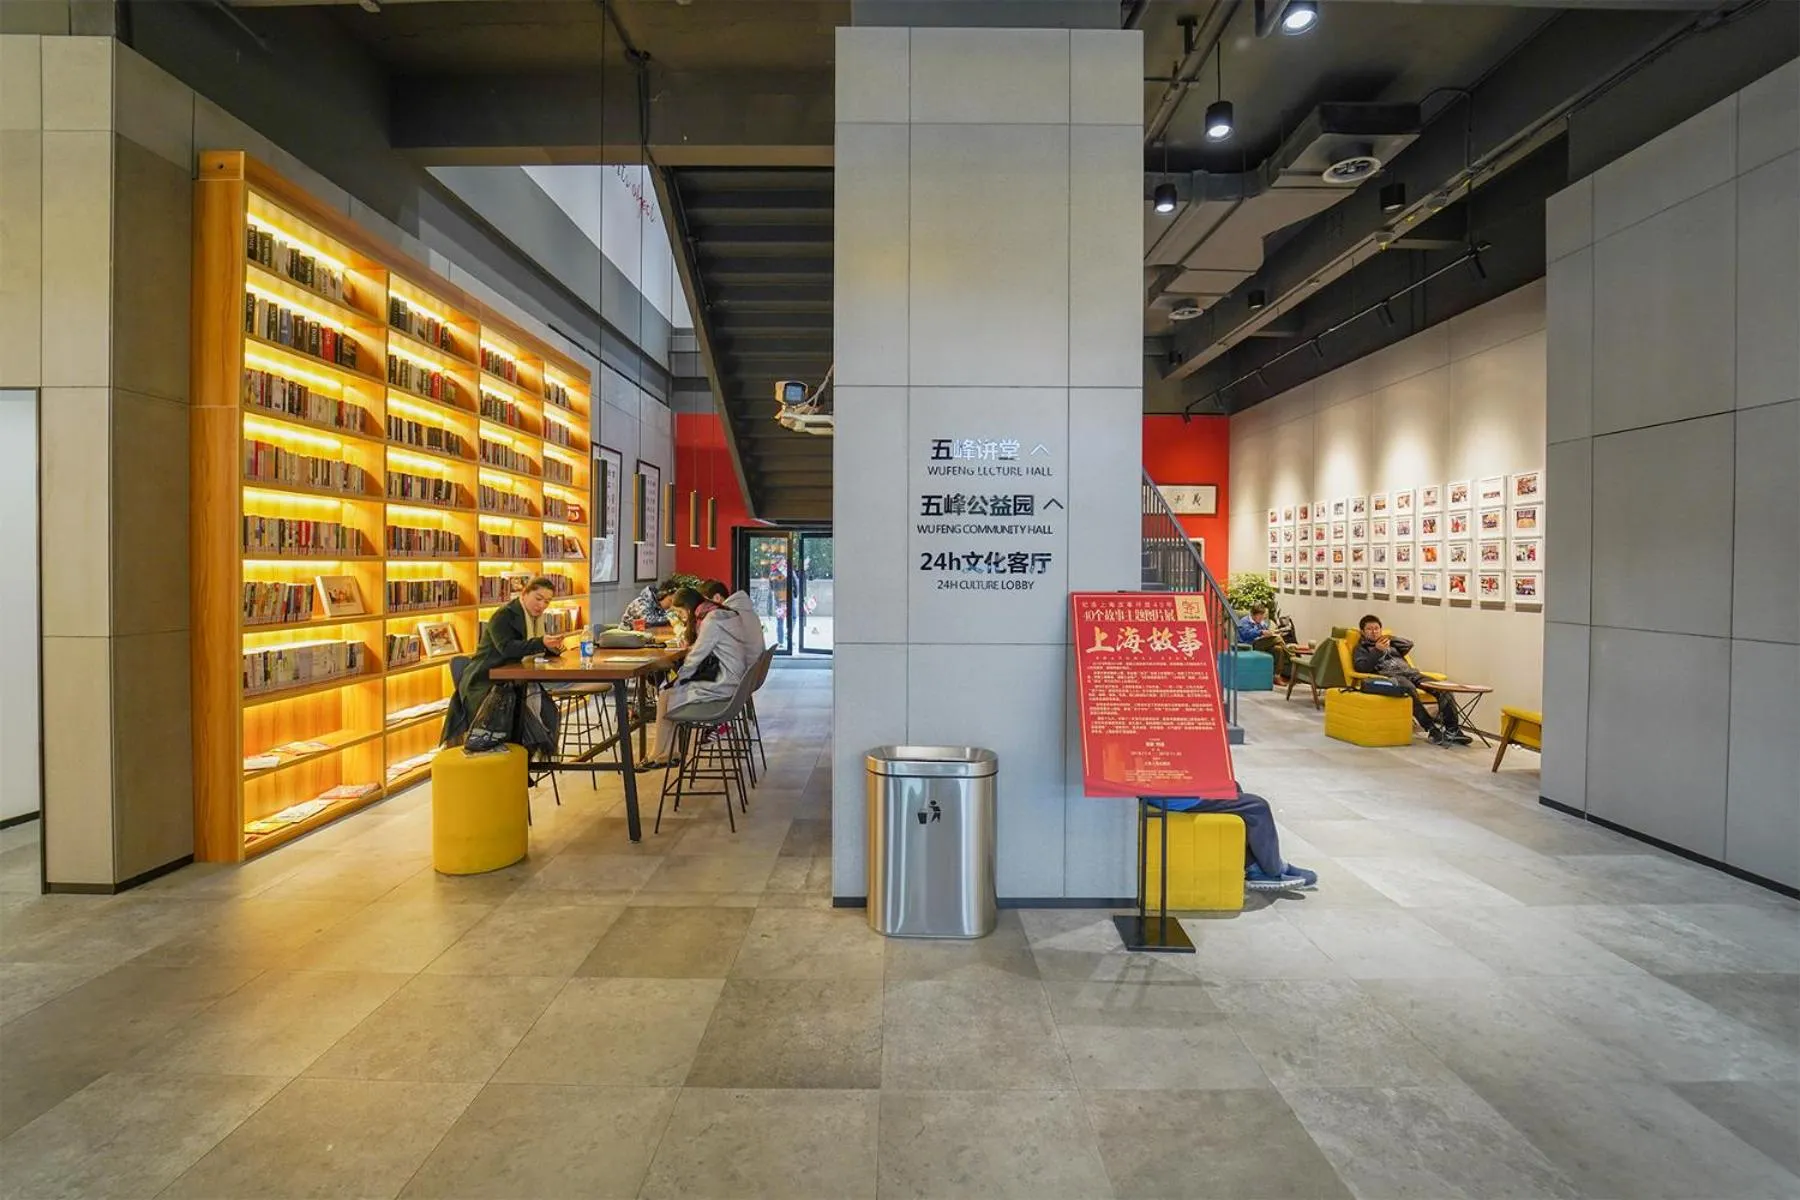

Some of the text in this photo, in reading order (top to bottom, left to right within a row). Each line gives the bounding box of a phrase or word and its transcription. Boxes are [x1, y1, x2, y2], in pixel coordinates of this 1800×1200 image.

[931, 438, 1020, 461] 五峰讲堂
[928, 466, 1053, 476] WUFENG LECTURE HALL
[920, 493, 1034, 516] 五峰公益园
[917, 524, 1053, 535] WUFENG COMMUNITY HALL
[920, 551, 1052, 574] 24h文化客厅
[937, 580, 1035, 590] 24H CULTURE LOBBY
[1085, 625, 1203, 657] 上海故事
